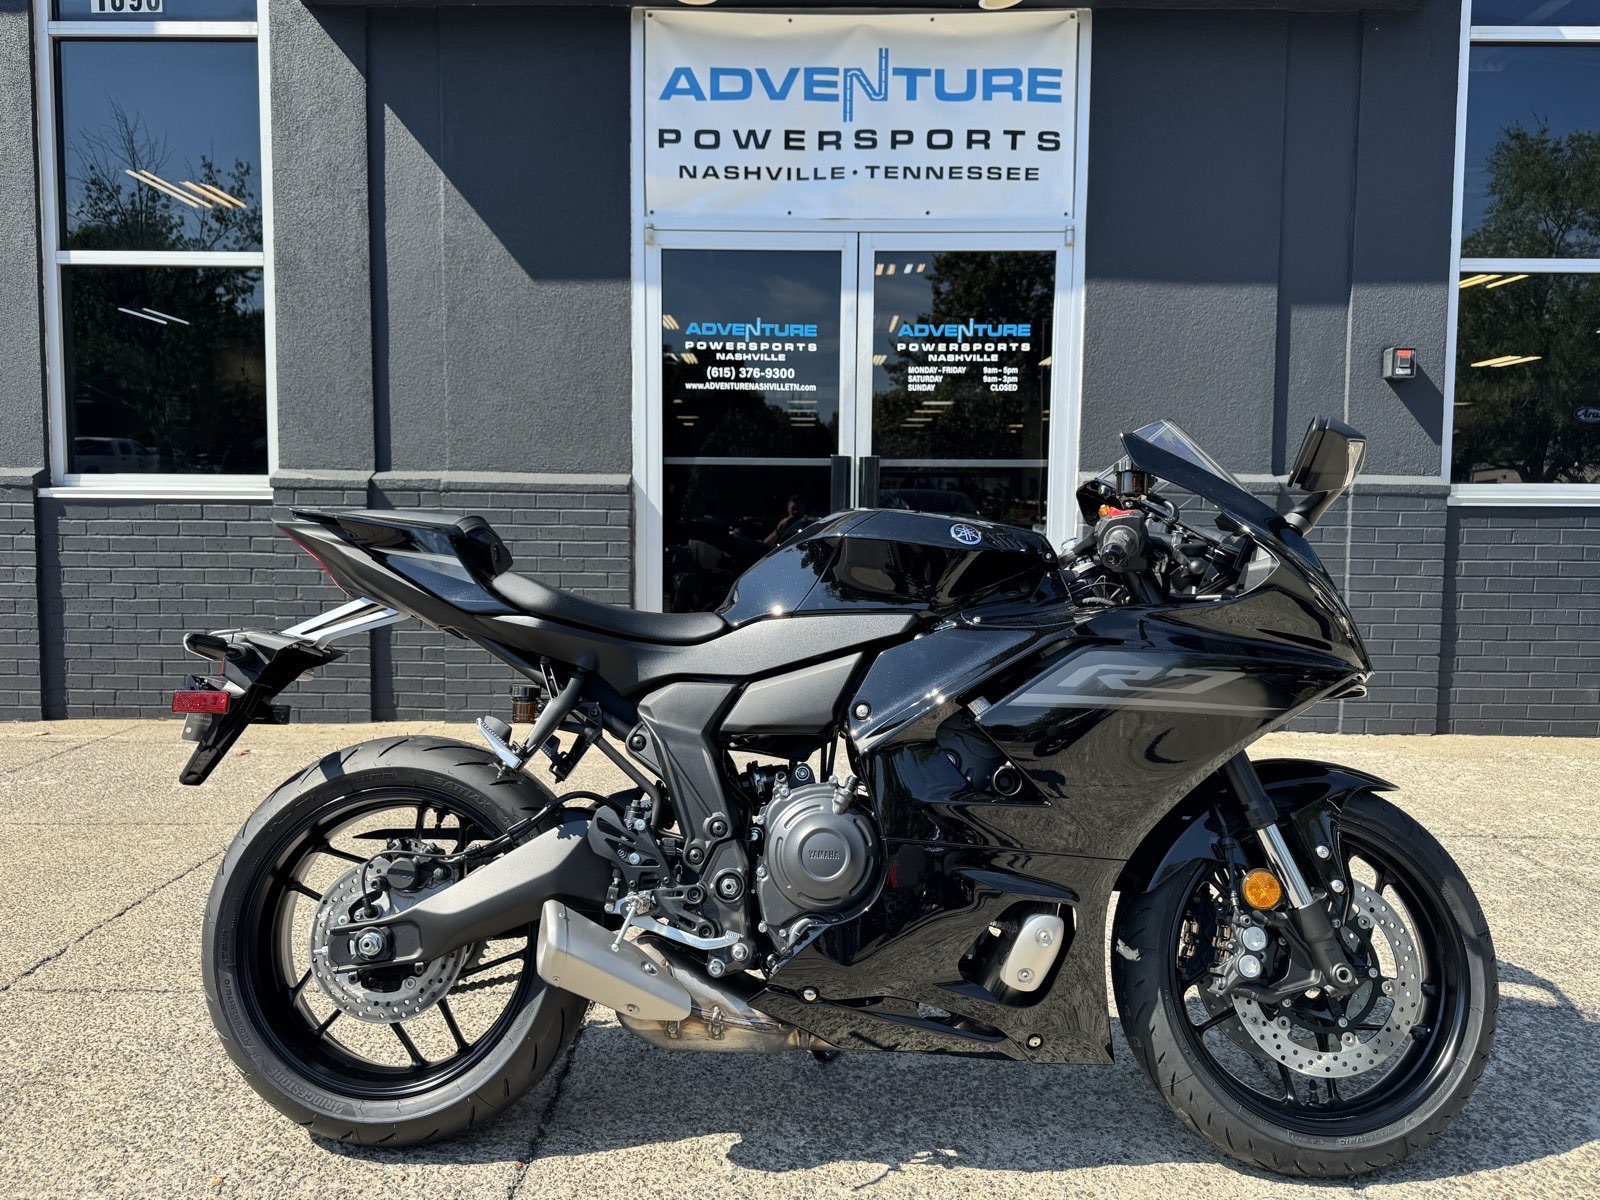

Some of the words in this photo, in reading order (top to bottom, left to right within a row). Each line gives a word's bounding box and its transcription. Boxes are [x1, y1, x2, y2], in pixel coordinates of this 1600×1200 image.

[659, 48, 1063, 123] ADVENTURE
[658, 128, 1061, 152] POWERSPORTS
[679, 165, 846, 181] NASHVILLE
[864, 165, 1040, 182] TENNESSEE
[685, 317, 818, 342] ADVENTURE
[897, 318, 1032, 343] ADVENTURE
[684, 341, 818, 352] POWERSPORTS
[896, 342, 1031, 352] POWERSPORTS
[715, 352, 786, 362] NASHVILLE
[927, 353, 999, 362] NASHVILLE
[706, 366, 736, 380] (615)
[738, 367, 796, 379] 376-9300
[907, 375, 944, 383] SATURDAY
[684, 381, 817, 392] www.ADVENTURENASHVILLETN.com
[907, 384, 936, 392] SUNDAY
[989, 384, 1019, 392] CLOSED
[1576, 408, 1600, 421] Ara
[808, 849, 841, 860] YAMAHA
[267, 1065, 347, 1115] BRIDGESTONE
